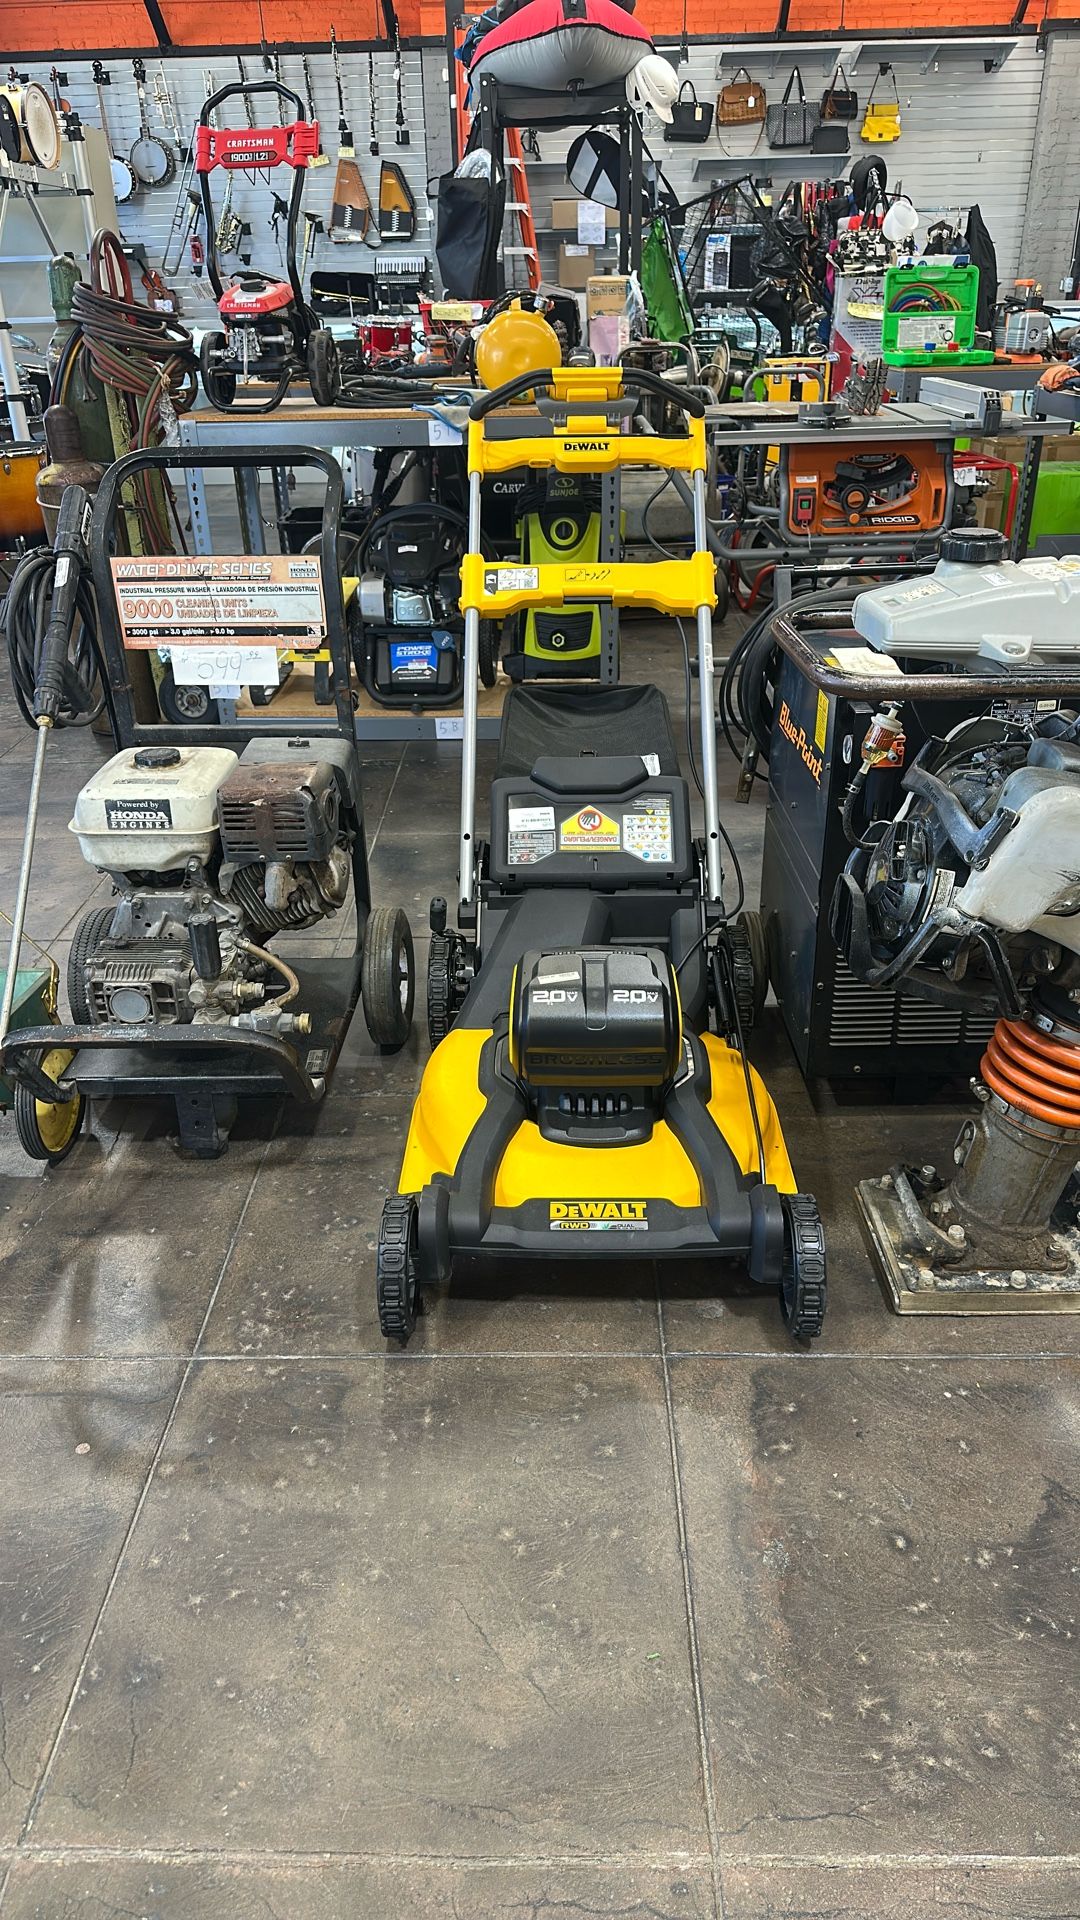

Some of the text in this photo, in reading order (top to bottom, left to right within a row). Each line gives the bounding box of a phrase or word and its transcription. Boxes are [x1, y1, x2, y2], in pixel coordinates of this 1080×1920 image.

[227, 138, 274, 148] CRAFTSMAN
[231, 152, 250, 161] 1900
[871, 516, 915, 525] RIDGID
[220, 562, 273, 575] SERIES
[258, 584, 283, 592] PRESIÓN
[176, 598, 248, 608] CLEANING UNITS
[123, 599, 173, 619] 9000
[177, 608, 279, 618] UNIDADES DE LIMPIEZA
[149, 629, 159, 637] psi
[150, 801, 159, 809] by
[109, 811, 169, 820] HONDA
[111, 821, 170, 829] ENGINES
[530, 1054, 662, 1066] BRUSHLESS
